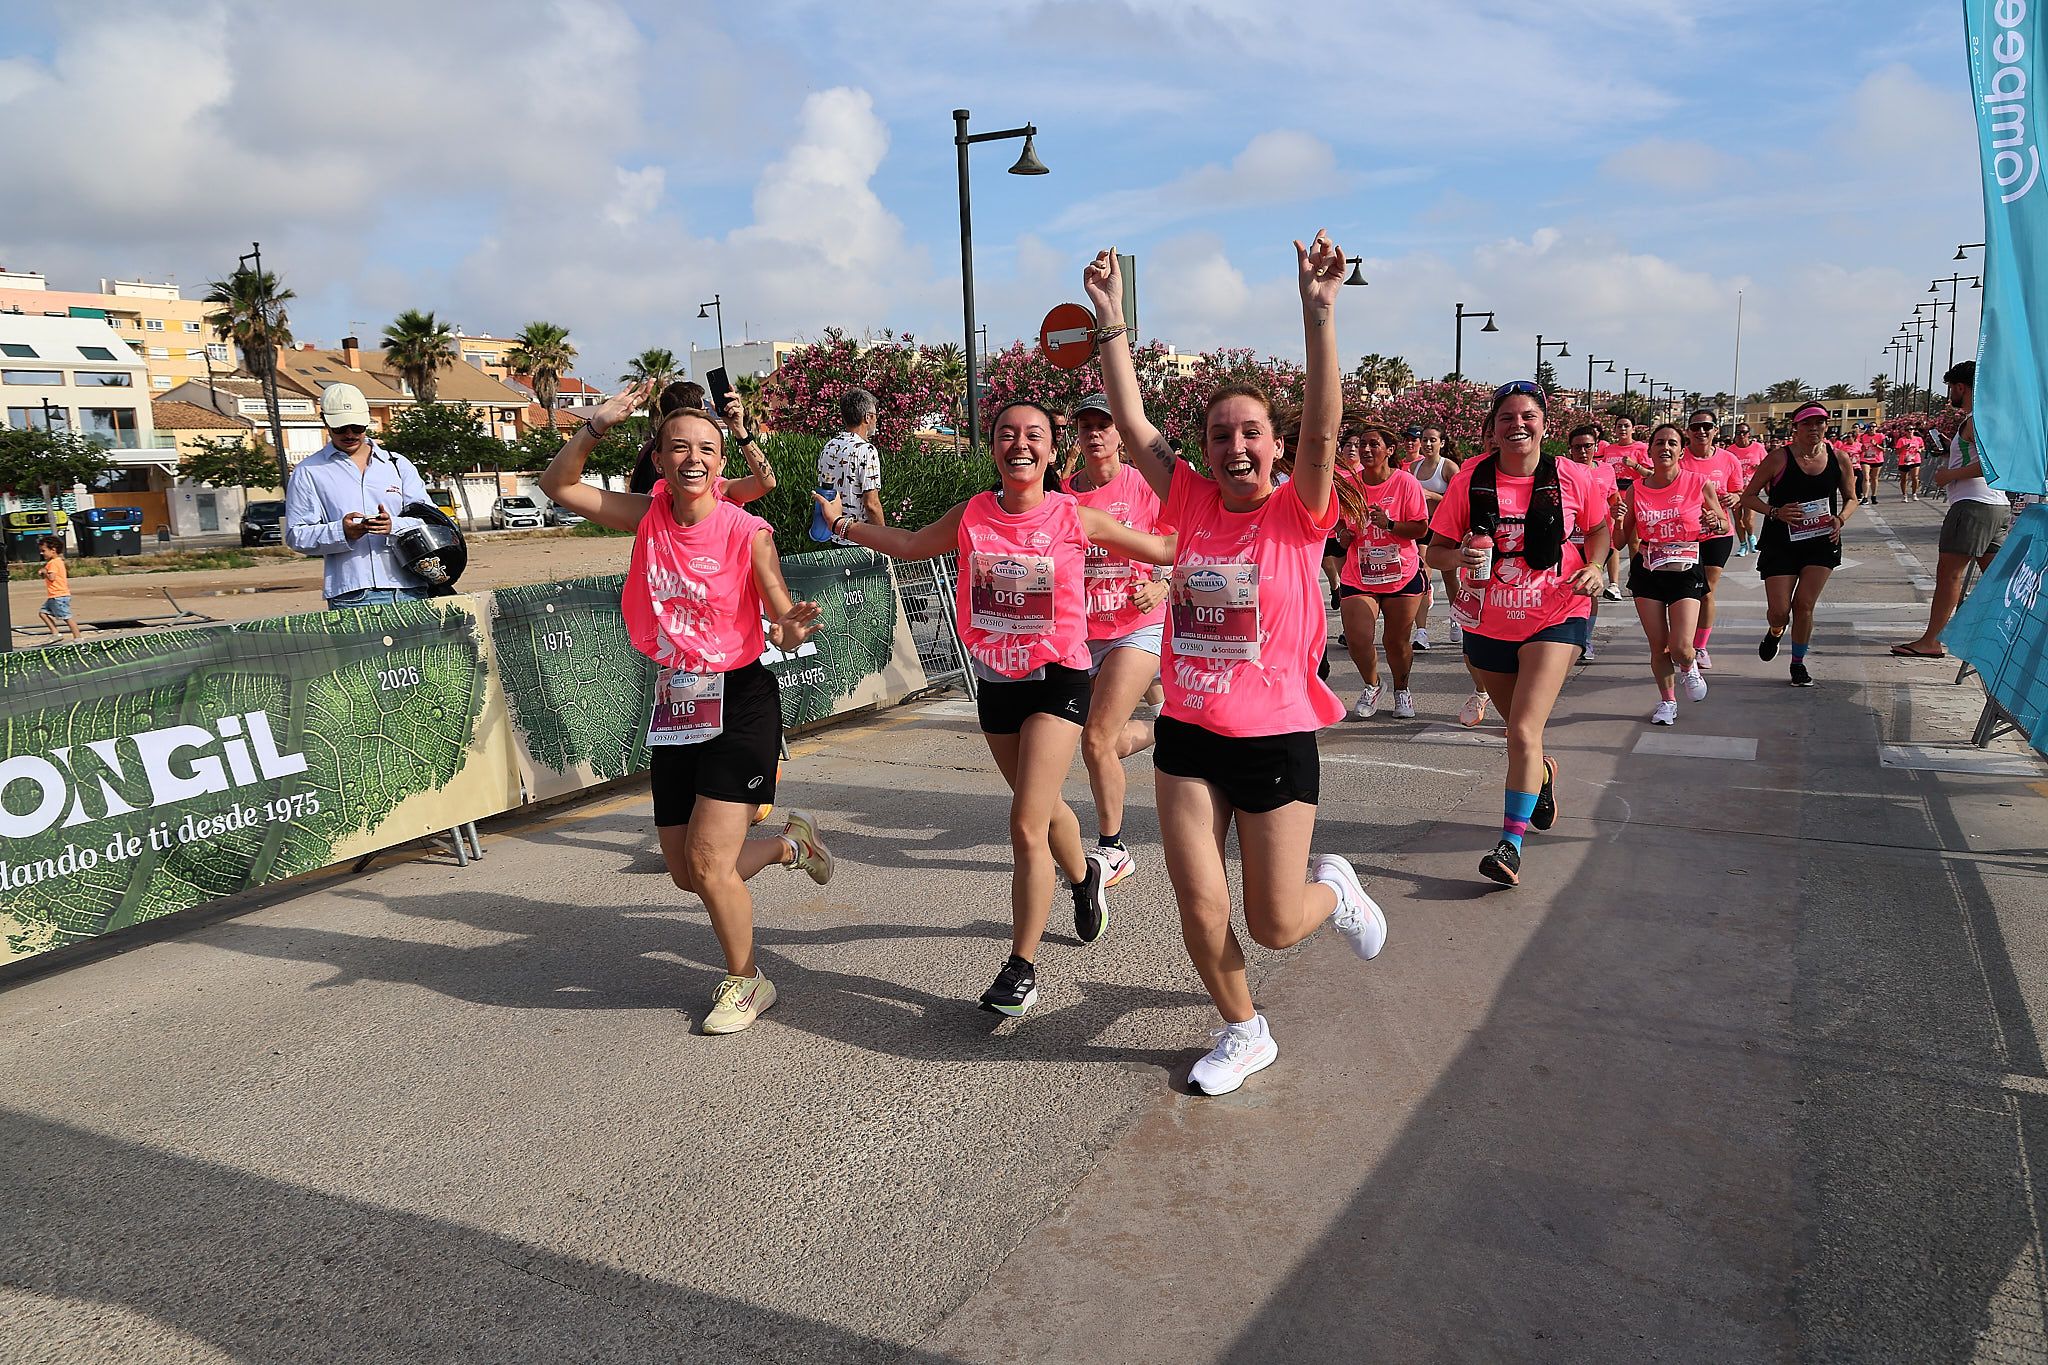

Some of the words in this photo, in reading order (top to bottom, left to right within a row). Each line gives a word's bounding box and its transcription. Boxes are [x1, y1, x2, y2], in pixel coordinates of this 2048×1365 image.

[1803, 517, 1820, 526] 016
[1660, 522, 1675, 539] DE
[995, 566, 1025, 576] ASTURIANA
[1371, 563, 1387, 571] 016
[1190, 578, 1224, 588] ASTURIANA
[844, 590, 865, 606] 2026
[995, 590, 1026, 606] 016
[1490, 588, 1542, 608] MUJER
[979, 618, 1004, 628] OYSHO
[1196, 607, 1225, 623] 016
[1506, 610, 1526, 620] 2026
[541, 630, 573, 652] 1975
[1180, 642, 1204, 652] OYSHO
[377, 666, 420, 691] 2026
[777, 670, 799, 690] sde
[800, 666, 825, 686] 1975
[1174, 663, 1233, 694] MUJER
[672, 701, 696, 716] 016
[1182, 693, 1204, 710] 2026
[107, 832, 143, 862] de
[148, 821, 170, 852] ti
[178, 802, 259, 845] desde
[258, 790, 321, 823] 1975
